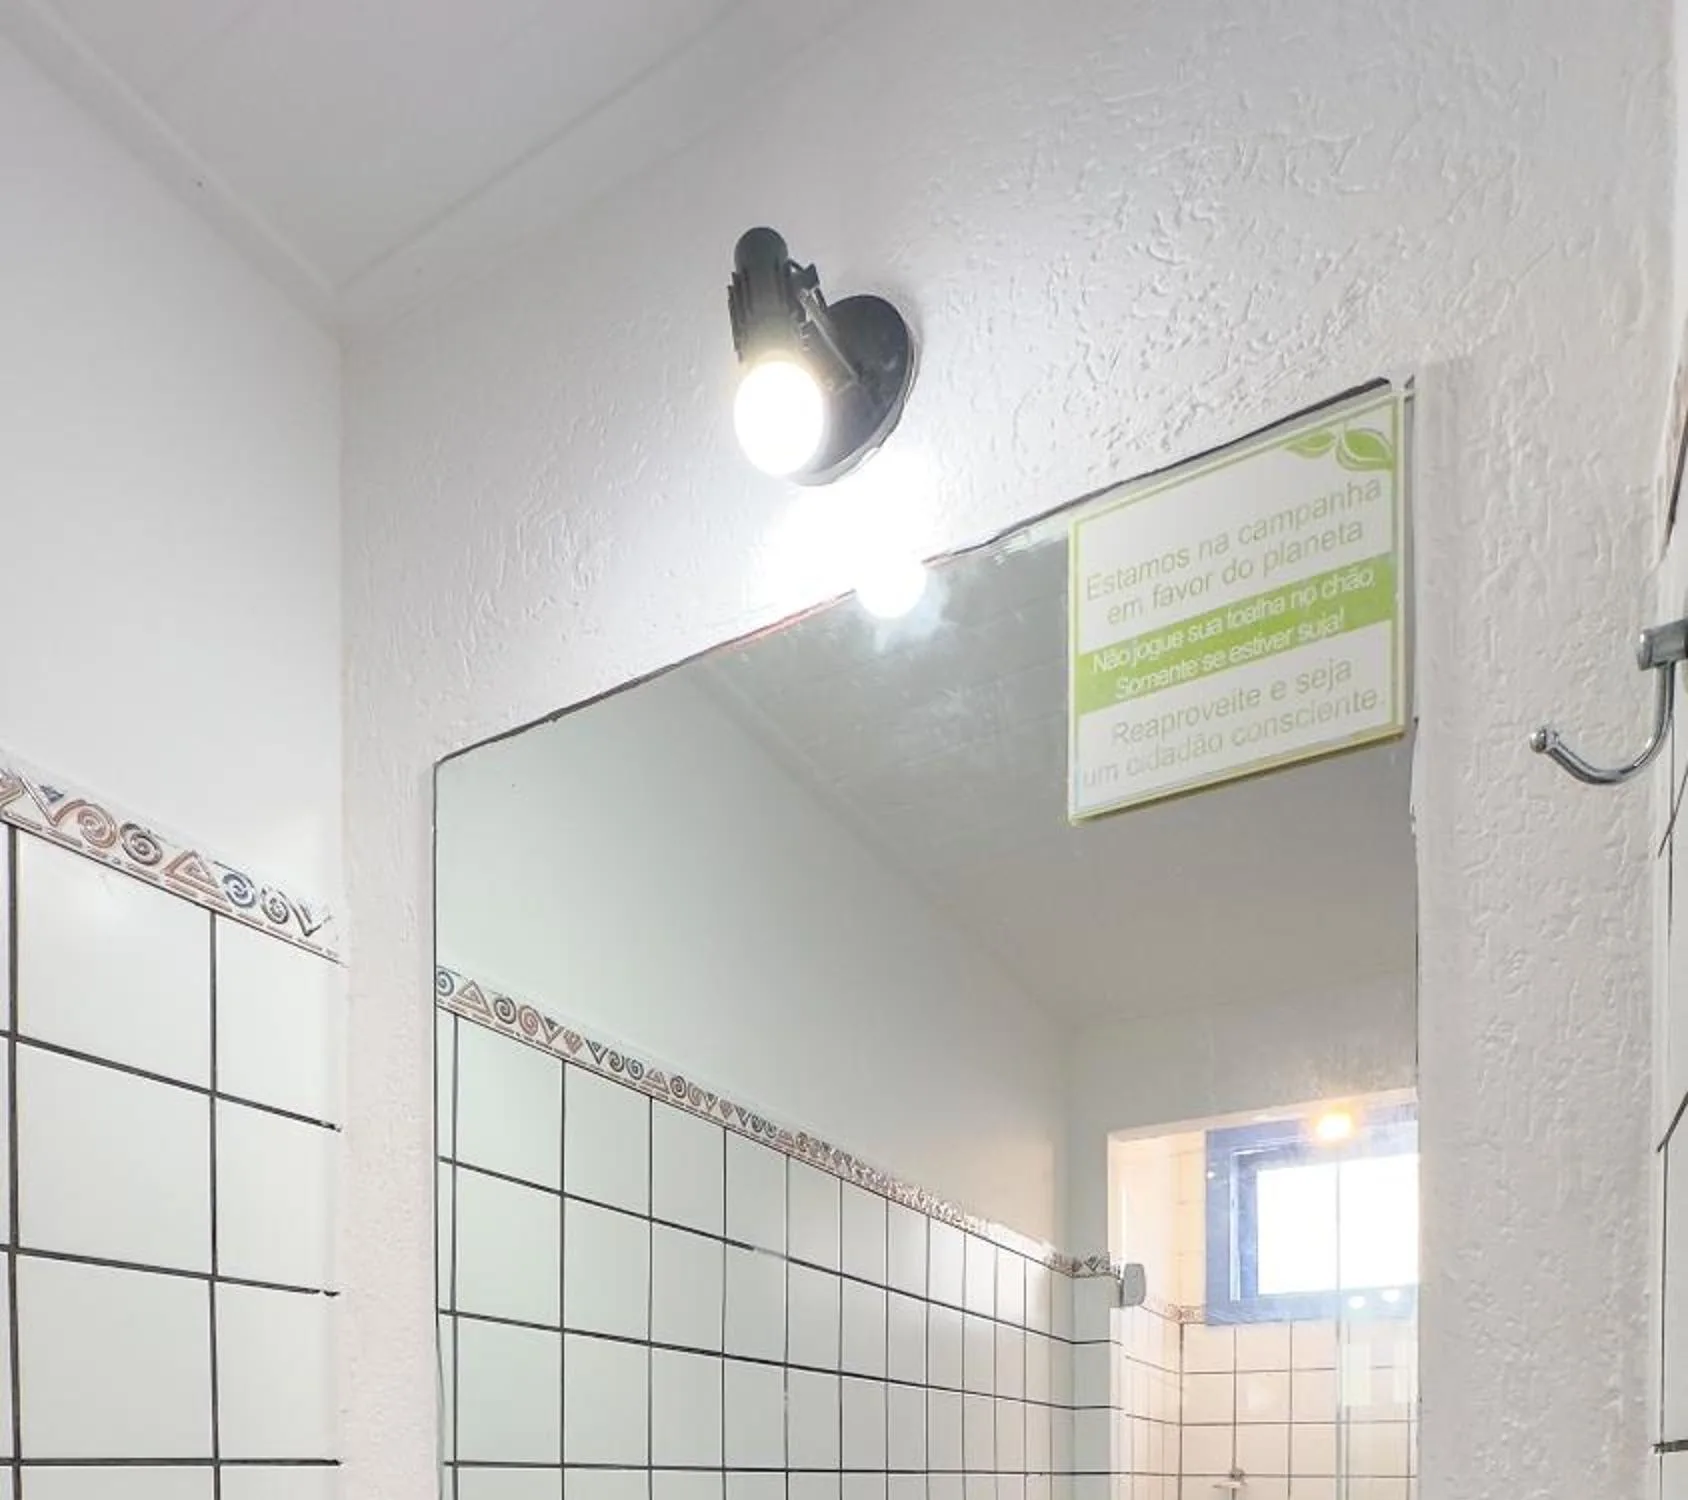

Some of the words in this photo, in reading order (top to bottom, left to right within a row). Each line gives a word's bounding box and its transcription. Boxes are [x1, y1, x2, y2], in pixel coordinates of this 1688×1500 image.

[1087, 547, 1190, 601] Estamos
[1198, 532, 1230, 560] na
[1238, 479, 1381, 545] campanha
[1107, 598, 1143, 625] em
[1153, 572, 1214, 609] favor
[1222, 557, 1254, 585] do
[1263, 521, 1363, 578] planeta
[1092, 645, 1131, 674] Não
[1131, 630, 1184, 669] jogue
[1188, 617, 1223, 643] sua
[1227, 595, 1285, 629] toalha
[1291, 586, 1317, 609] no
[1202, 650, 1226, 671] se
[1229, 627, 1293, 662] estiver
[1297, 605, 1344, 641] suja!
[1112, 686, 1261, 746] Reaproveite
[1270, 680, 1287, 701] e
[1296, 657, 1352, 695] seja
[1084, 763, 1118, 788] um
[1126, 731, 1223, 777] cidadão
